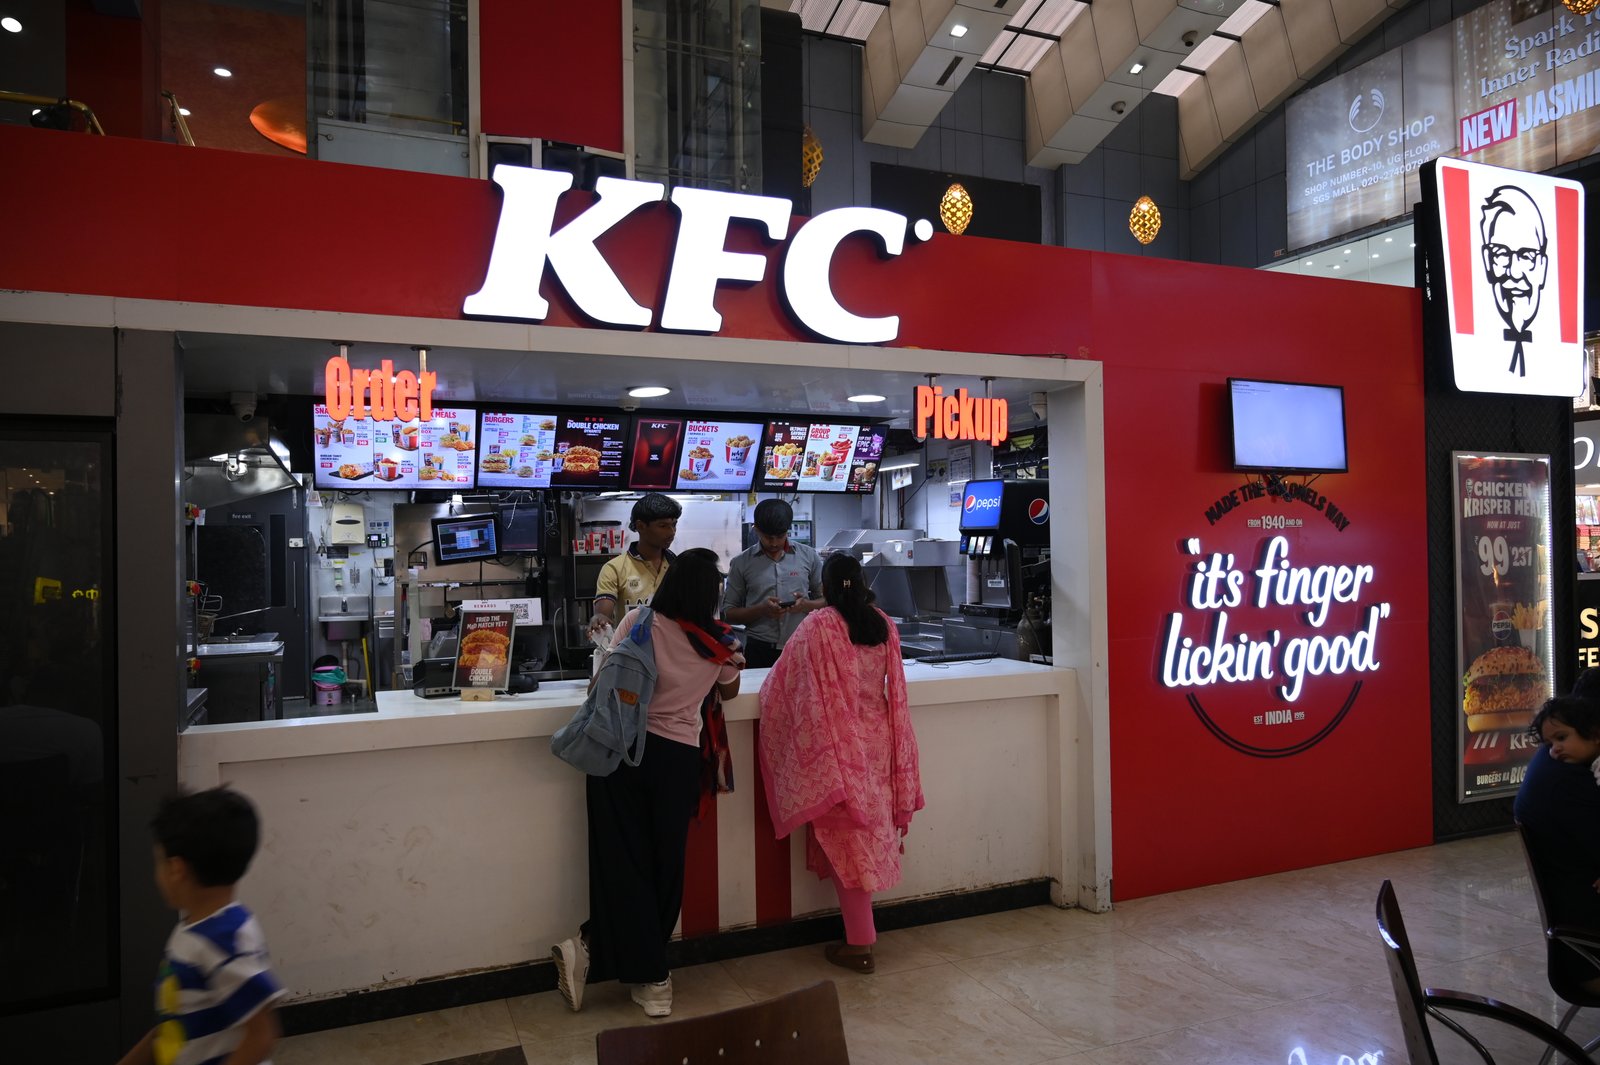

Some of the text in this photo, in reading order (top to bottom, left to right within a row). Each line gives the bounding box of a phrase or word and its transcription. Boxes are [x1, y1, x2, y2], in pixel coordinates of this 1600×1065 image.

[1504, 15, 1576, 60] Spark
[1481, 61, 1540, 97] Inner
[1463, 101, 1514, 153] NEW
[1306, 115, 1435, 178] THE BODY SHOP
[1304, 181, 1328, 197] SHOP
[1313, 186, 1331, 205] SGS
[462, 163, 908, 344] KFC
[324, 355, 437, 423] Order
[435, 411, 457, 419] MEALS
[484, 416, 515, 424] BURGERS
[915, 384, 1009, 447] Pickup
[567, 421, 592, 430] DOUBLE
[592, 423, 620, 431] CHICKEN
[688, 424, 719, 433] BUCKETS
[811, 427, 831, 435] GROUP
[1474, 481, 1531, 498] CHICKEN
[975, 496, 1001, 511] pepsi
[1204, 489, 1241, 526] MADE
[1325, 502, 1350, 532] WAY
[1463, 498, 1511, 518] KRISPER
[1247, 519, 1261, 527] FROM
[1261, 515, 1285, 529] 1940
[1487, 521, 1521, 529] NOW AT JUST
[1255, 535, 1374, 628] finger
[468, 674, 494, 682] CHICKEN
[1265, 709, 1293, 725] INDIA
[1476, 772, 1502, 786] BURGERS
